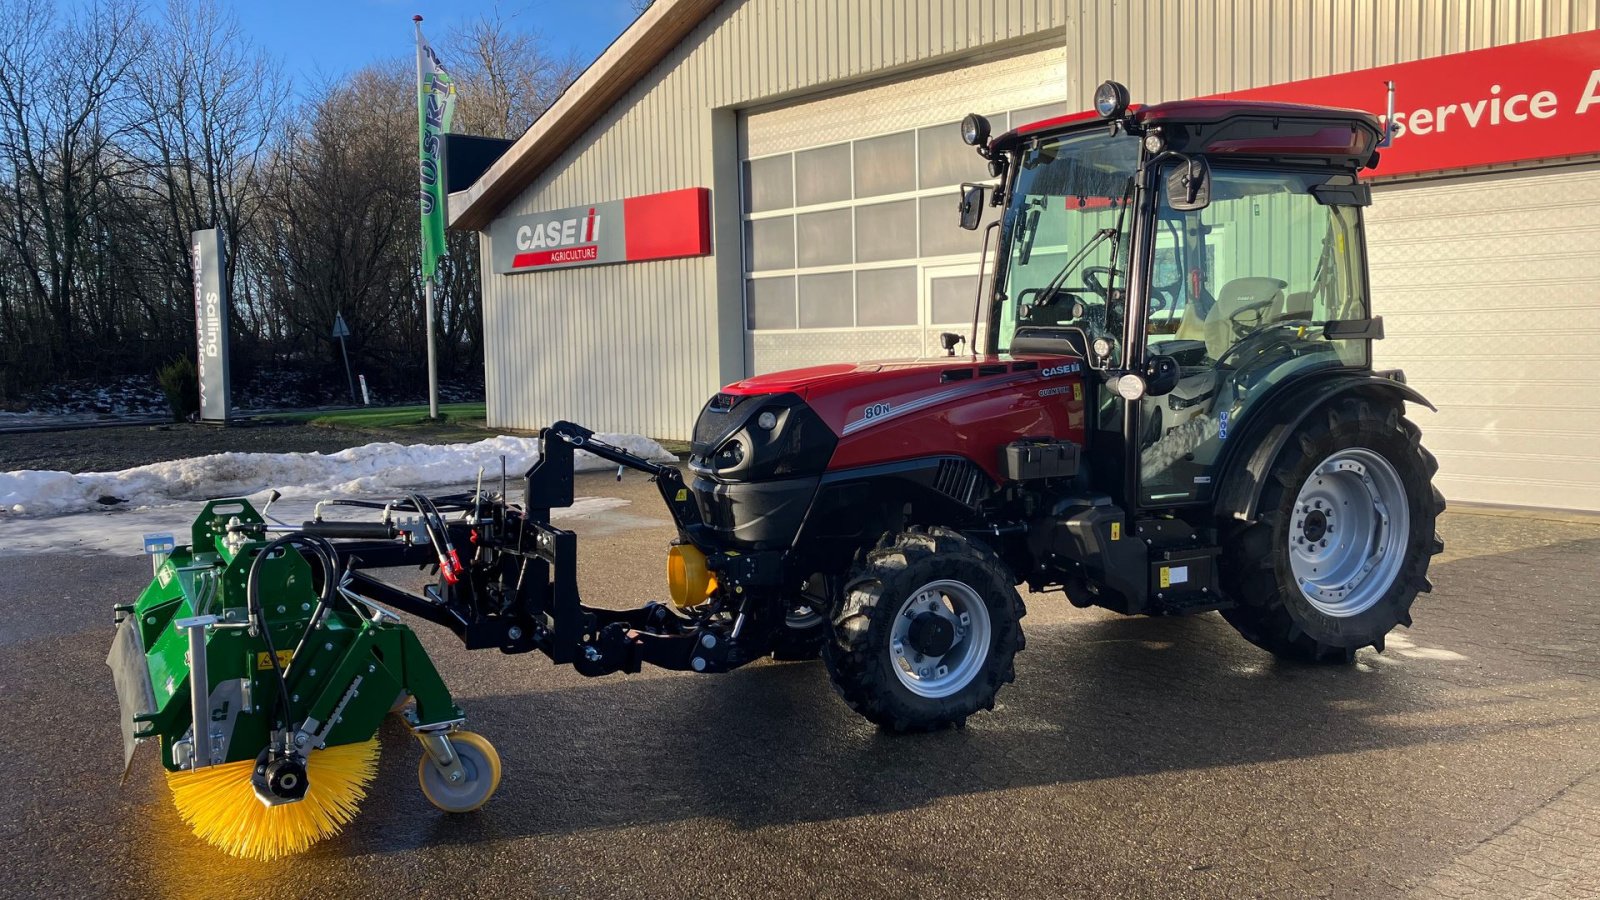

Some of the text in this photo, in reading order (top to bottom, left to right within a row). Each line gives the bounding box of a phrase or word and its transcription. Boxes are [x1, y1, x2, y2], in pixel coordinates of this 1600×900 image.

[516, 218, 577, 251] CASE
[550, 248, 596, 262] AGRICULTURE
[193, 241, 205, 378] Traktorservice
[206, 292, 219, 358] Salling
[1042, 364, 1071, 377] CASE
